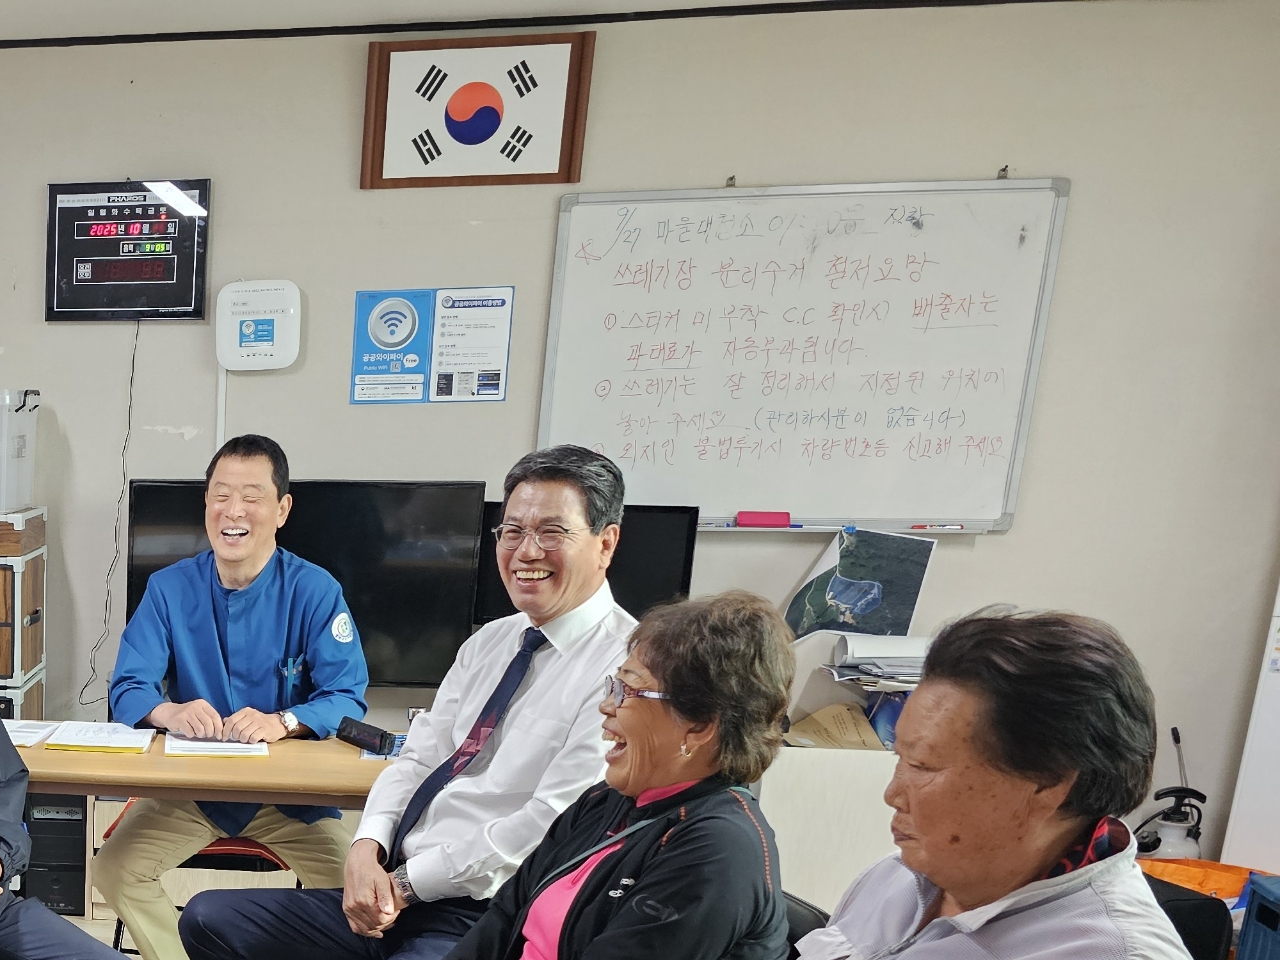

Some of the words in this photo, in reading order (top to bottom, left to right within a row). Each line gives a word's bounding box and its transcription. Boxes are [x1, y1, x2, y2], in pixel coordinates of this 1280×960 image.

[123, 208, 131, 216] 수
[147, 206, 155, 215] 금
[612, 257, 698, 294] 쓰레기장
[711, 256, 805, 297] 분리수거
[620, 308, 681, 335] 스티커
[362, 352, 404, 363] 공공와이파이
[627, 339, 703, 371] 과태료가
[619, 374, 697, 407] 쓰레기는
[723, 373, 747, 400] 잘
[761, 371, 836, 400] 정리해서
[858, 370, 925, 399] 지정된
[617, 438, 675, 470] 외지인
